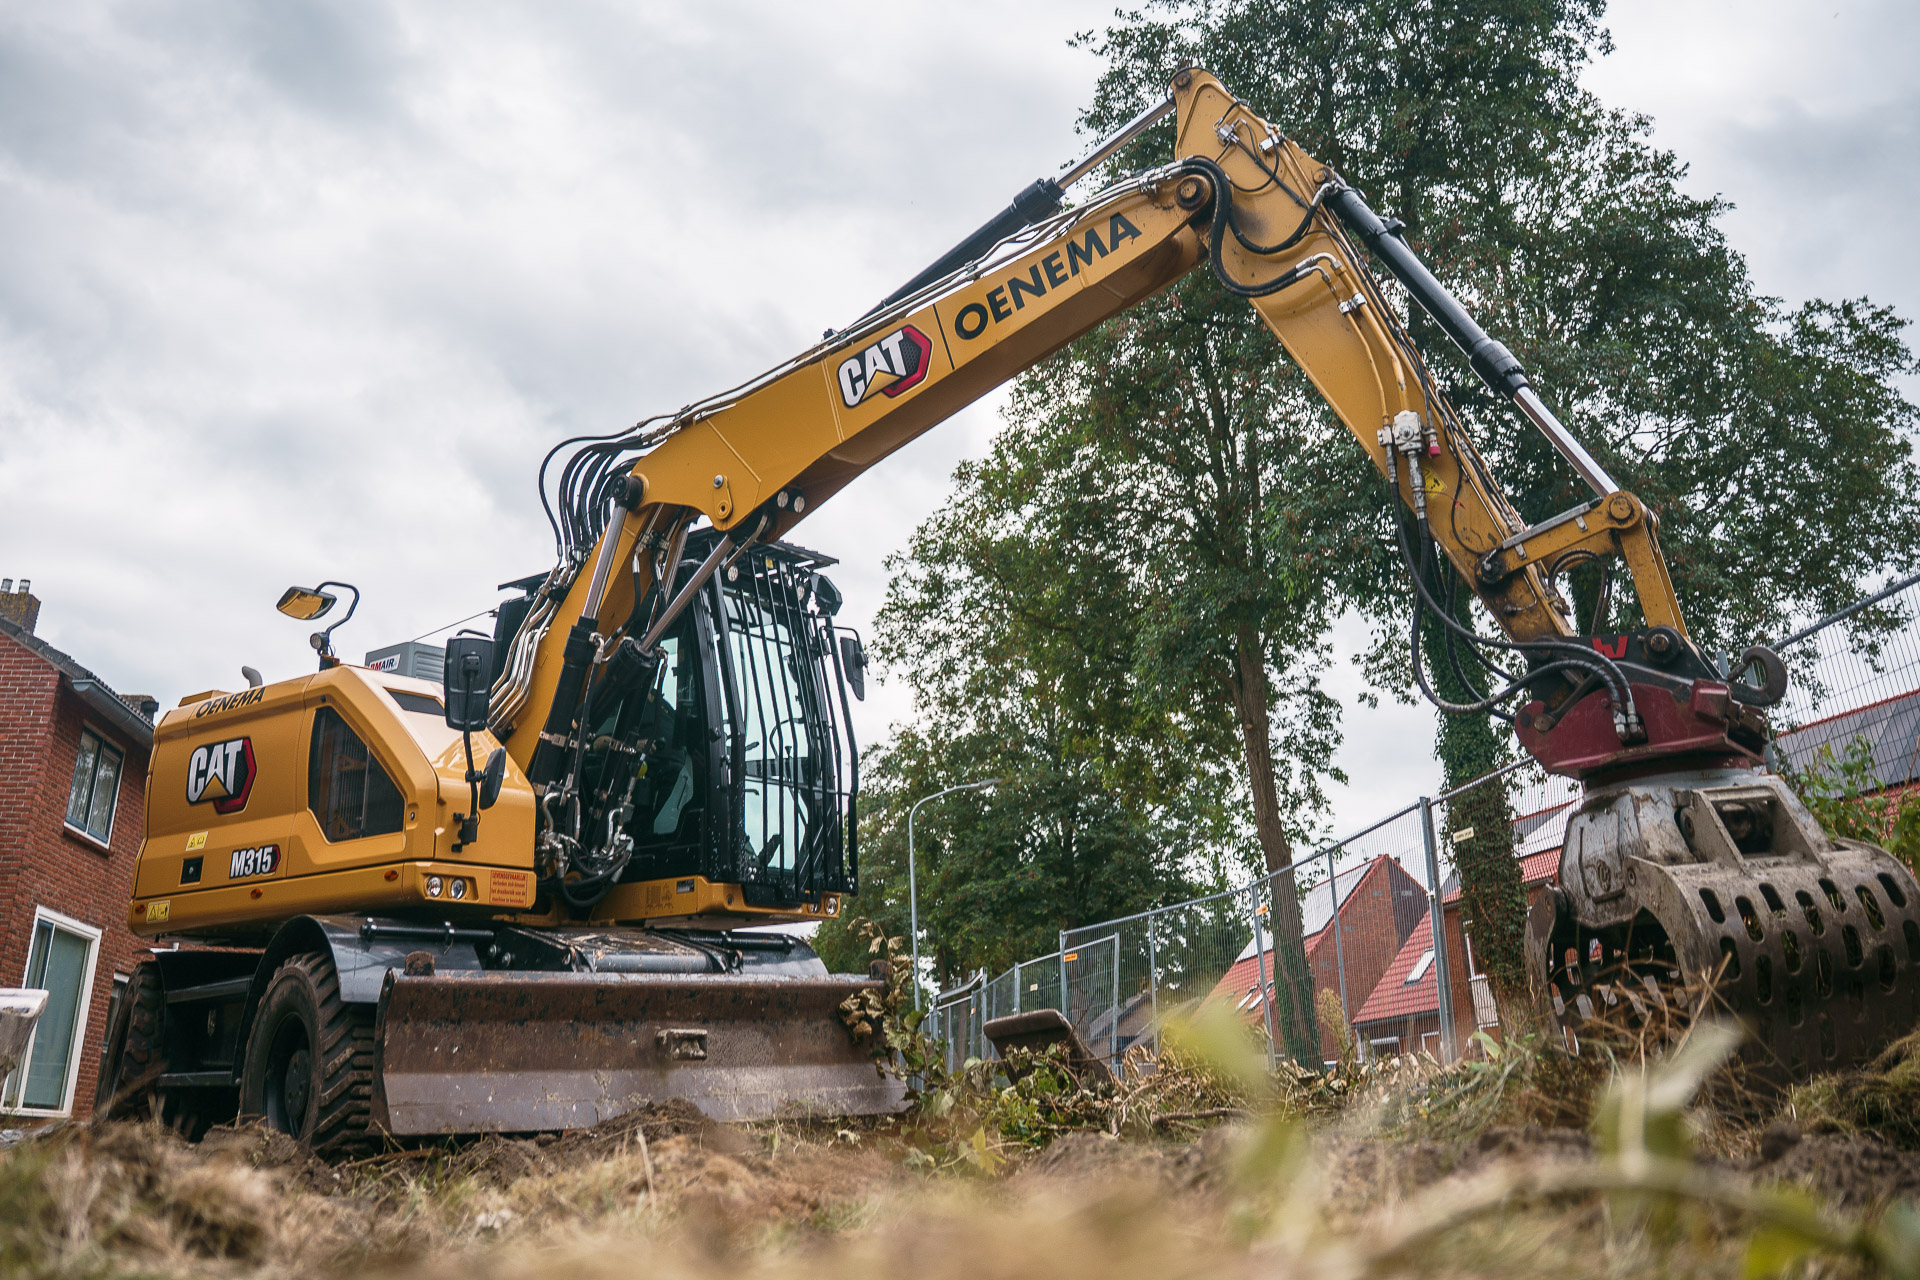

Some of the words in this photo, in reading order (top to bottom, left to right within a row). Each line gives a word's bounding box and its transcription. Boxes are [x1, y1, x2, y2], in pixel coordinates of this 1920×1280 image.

[955, 212, 1142, 340] OENEMA
[838, 329, 907, 407] CAT
[196, 687, 266, 718] OENEMA
[187, 739, 243, 803] CAT
[230, 846, 273, 878] M315
